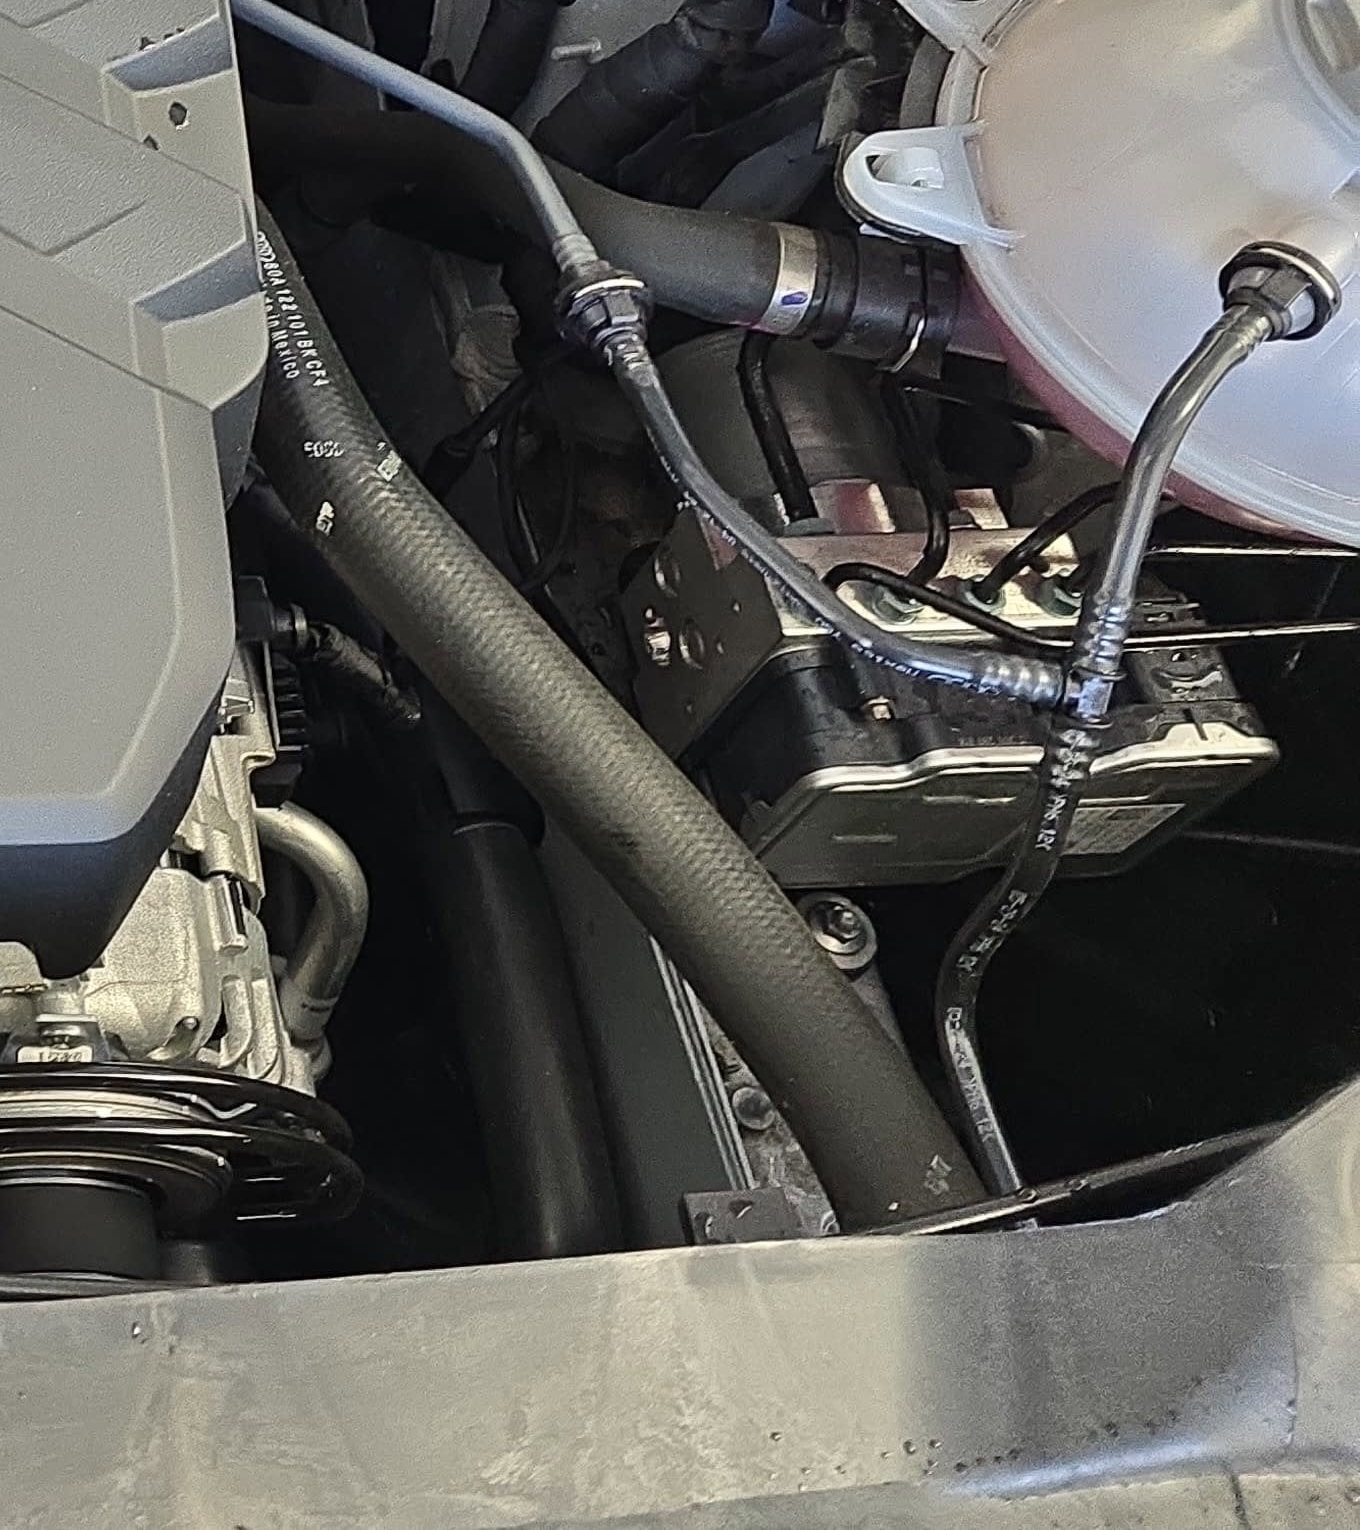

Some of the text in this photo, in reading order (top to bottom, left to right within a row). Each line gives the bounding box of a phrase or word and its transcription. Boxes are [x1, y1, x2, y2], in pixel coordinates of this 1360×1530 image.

[263, 262, 287, 286] 80A
[287, 314, 309, 337] 101
[271, 329, 300, 379] Mexico
